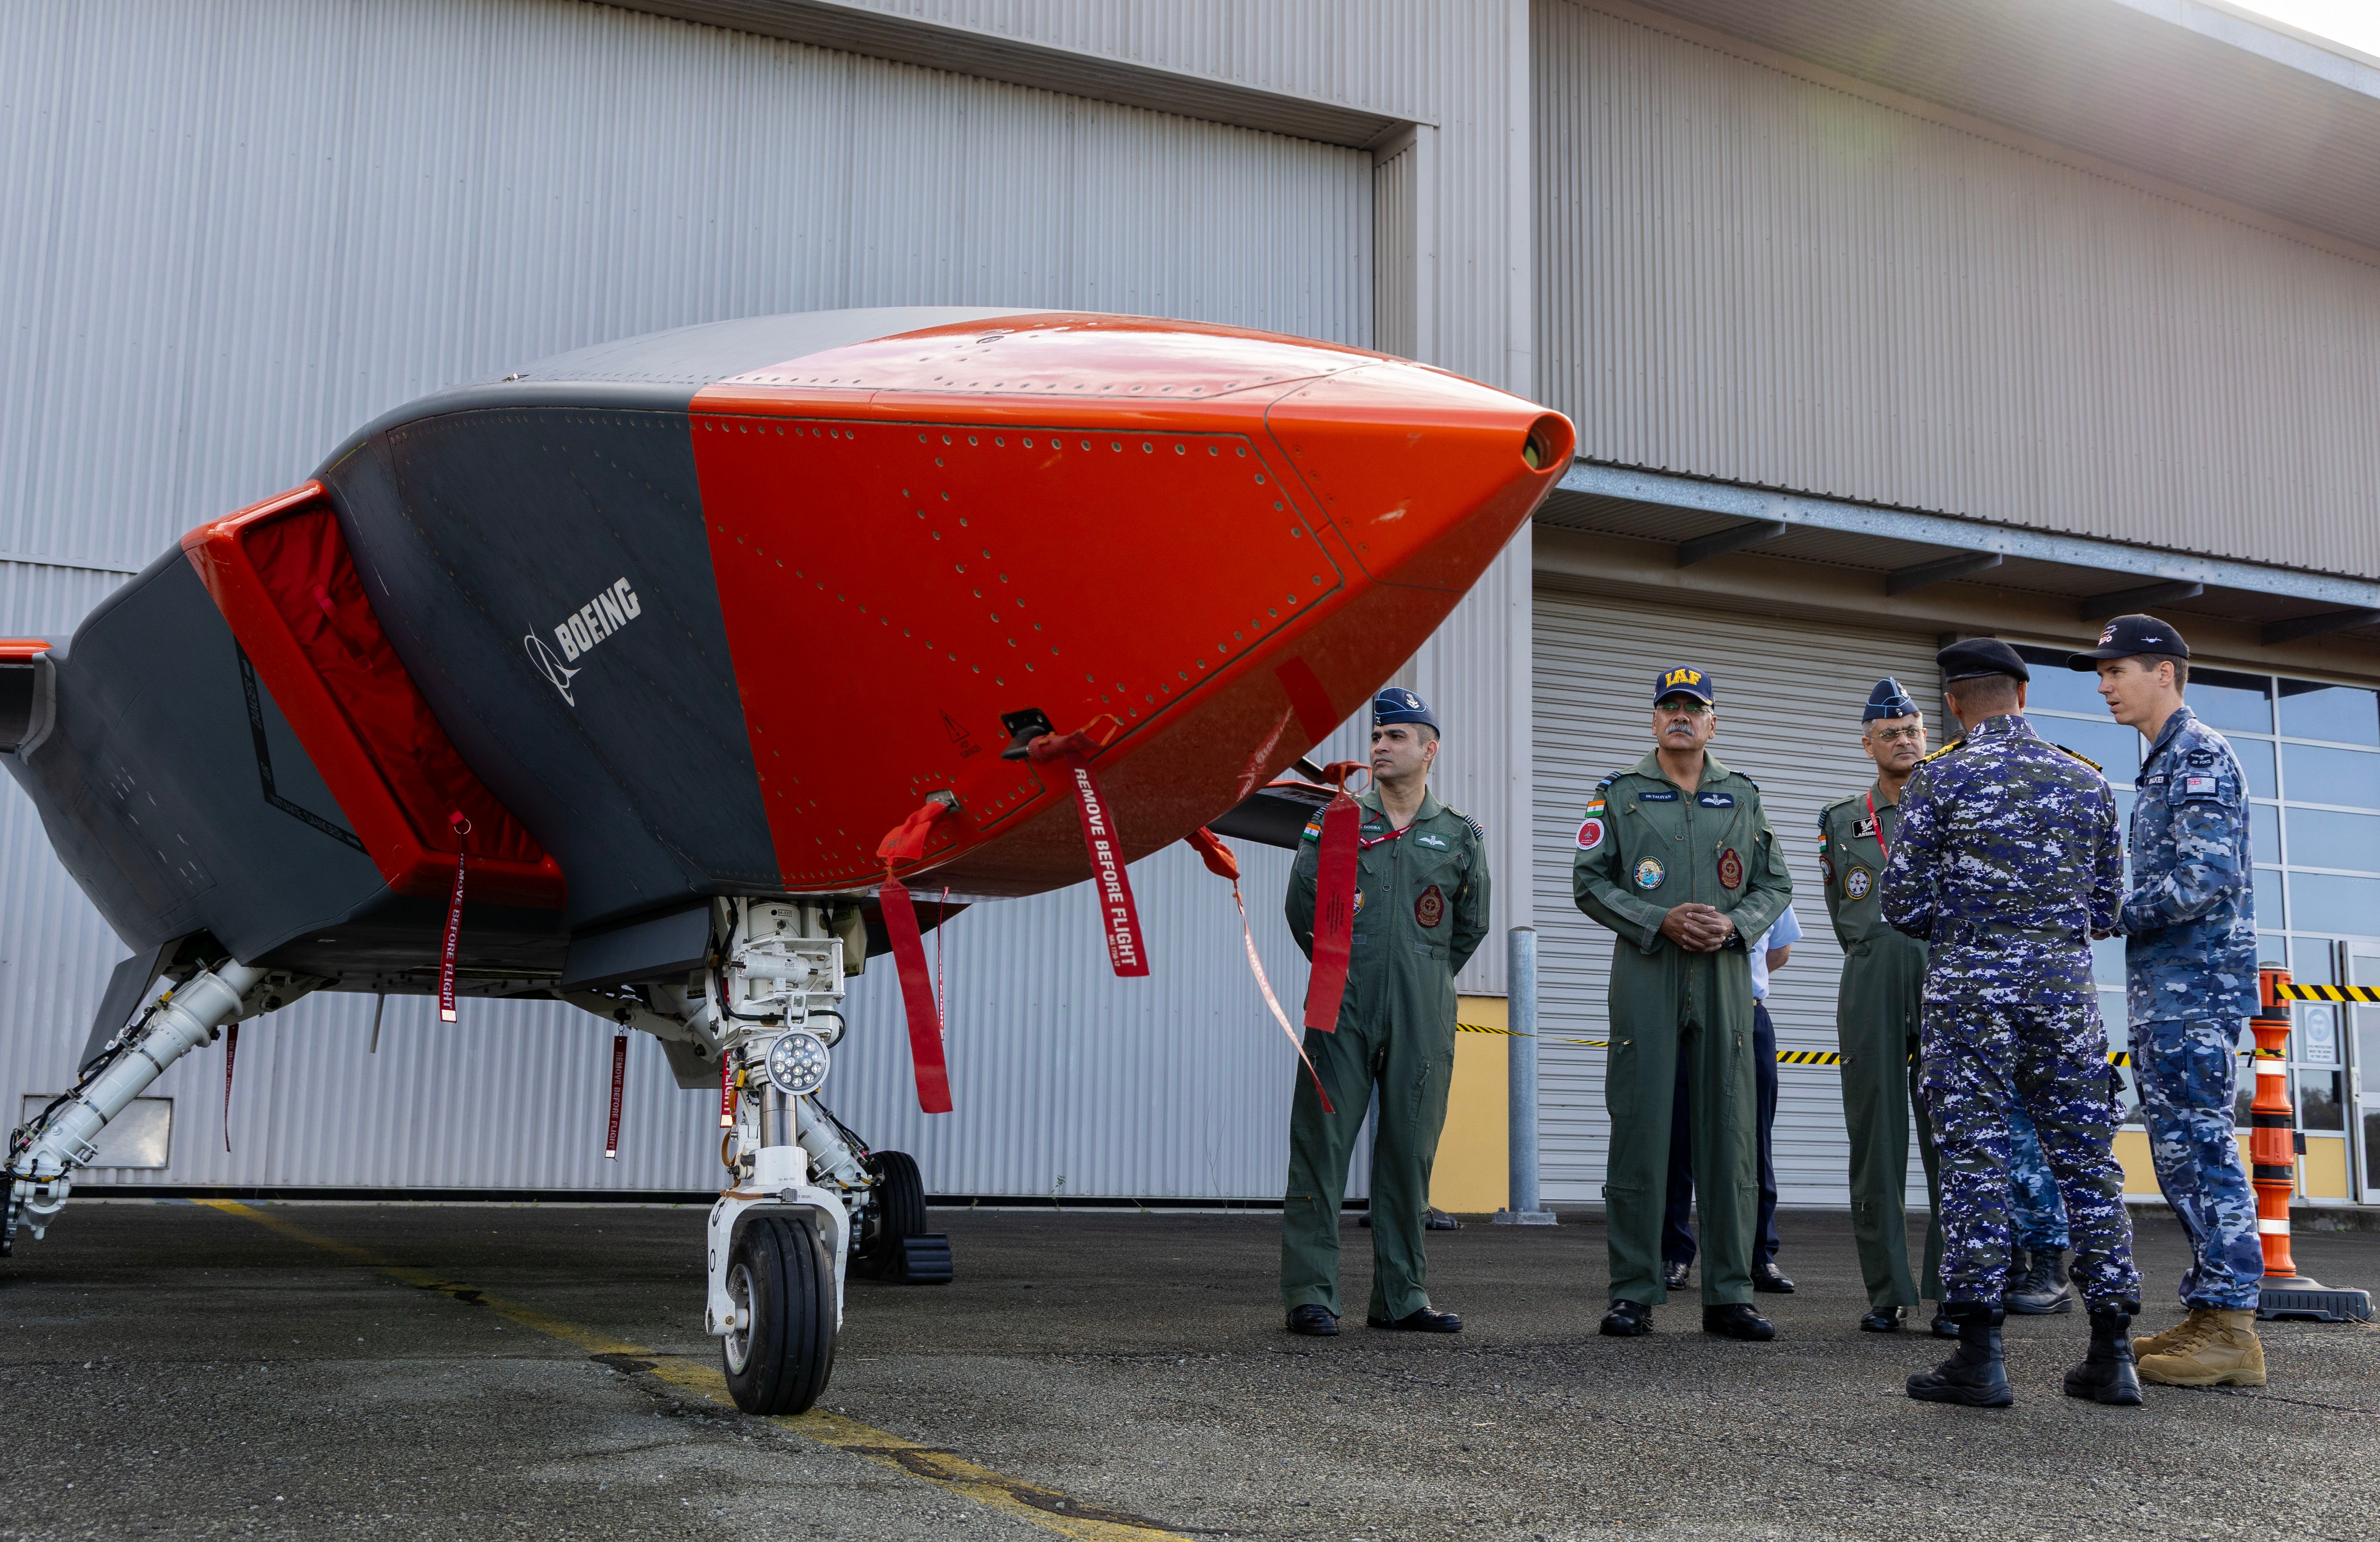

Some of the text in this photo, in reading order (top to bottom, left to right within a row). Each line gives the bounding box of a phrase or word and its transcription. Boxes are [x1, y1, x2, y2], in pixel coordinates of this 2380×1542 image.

[554, 577, 641, 662] BOEING
[245, 677, 262, 730] DANGER
[1665, 668, 1701, 688] IAF
[262, 762, 272, 784] AIR
[269, 793, 342, 841] INTAKE DANGER
[1074, 768, 1137, 967] REMOVE BEFORE FLIGHT
[443, 852, 465, 1009] REMOVE BEFORE FLIGHT
[1245, 934, 1270, 995] REMOVE
[608, 1052, 623, 1150] REMOVE BEFORE FLIGHT
